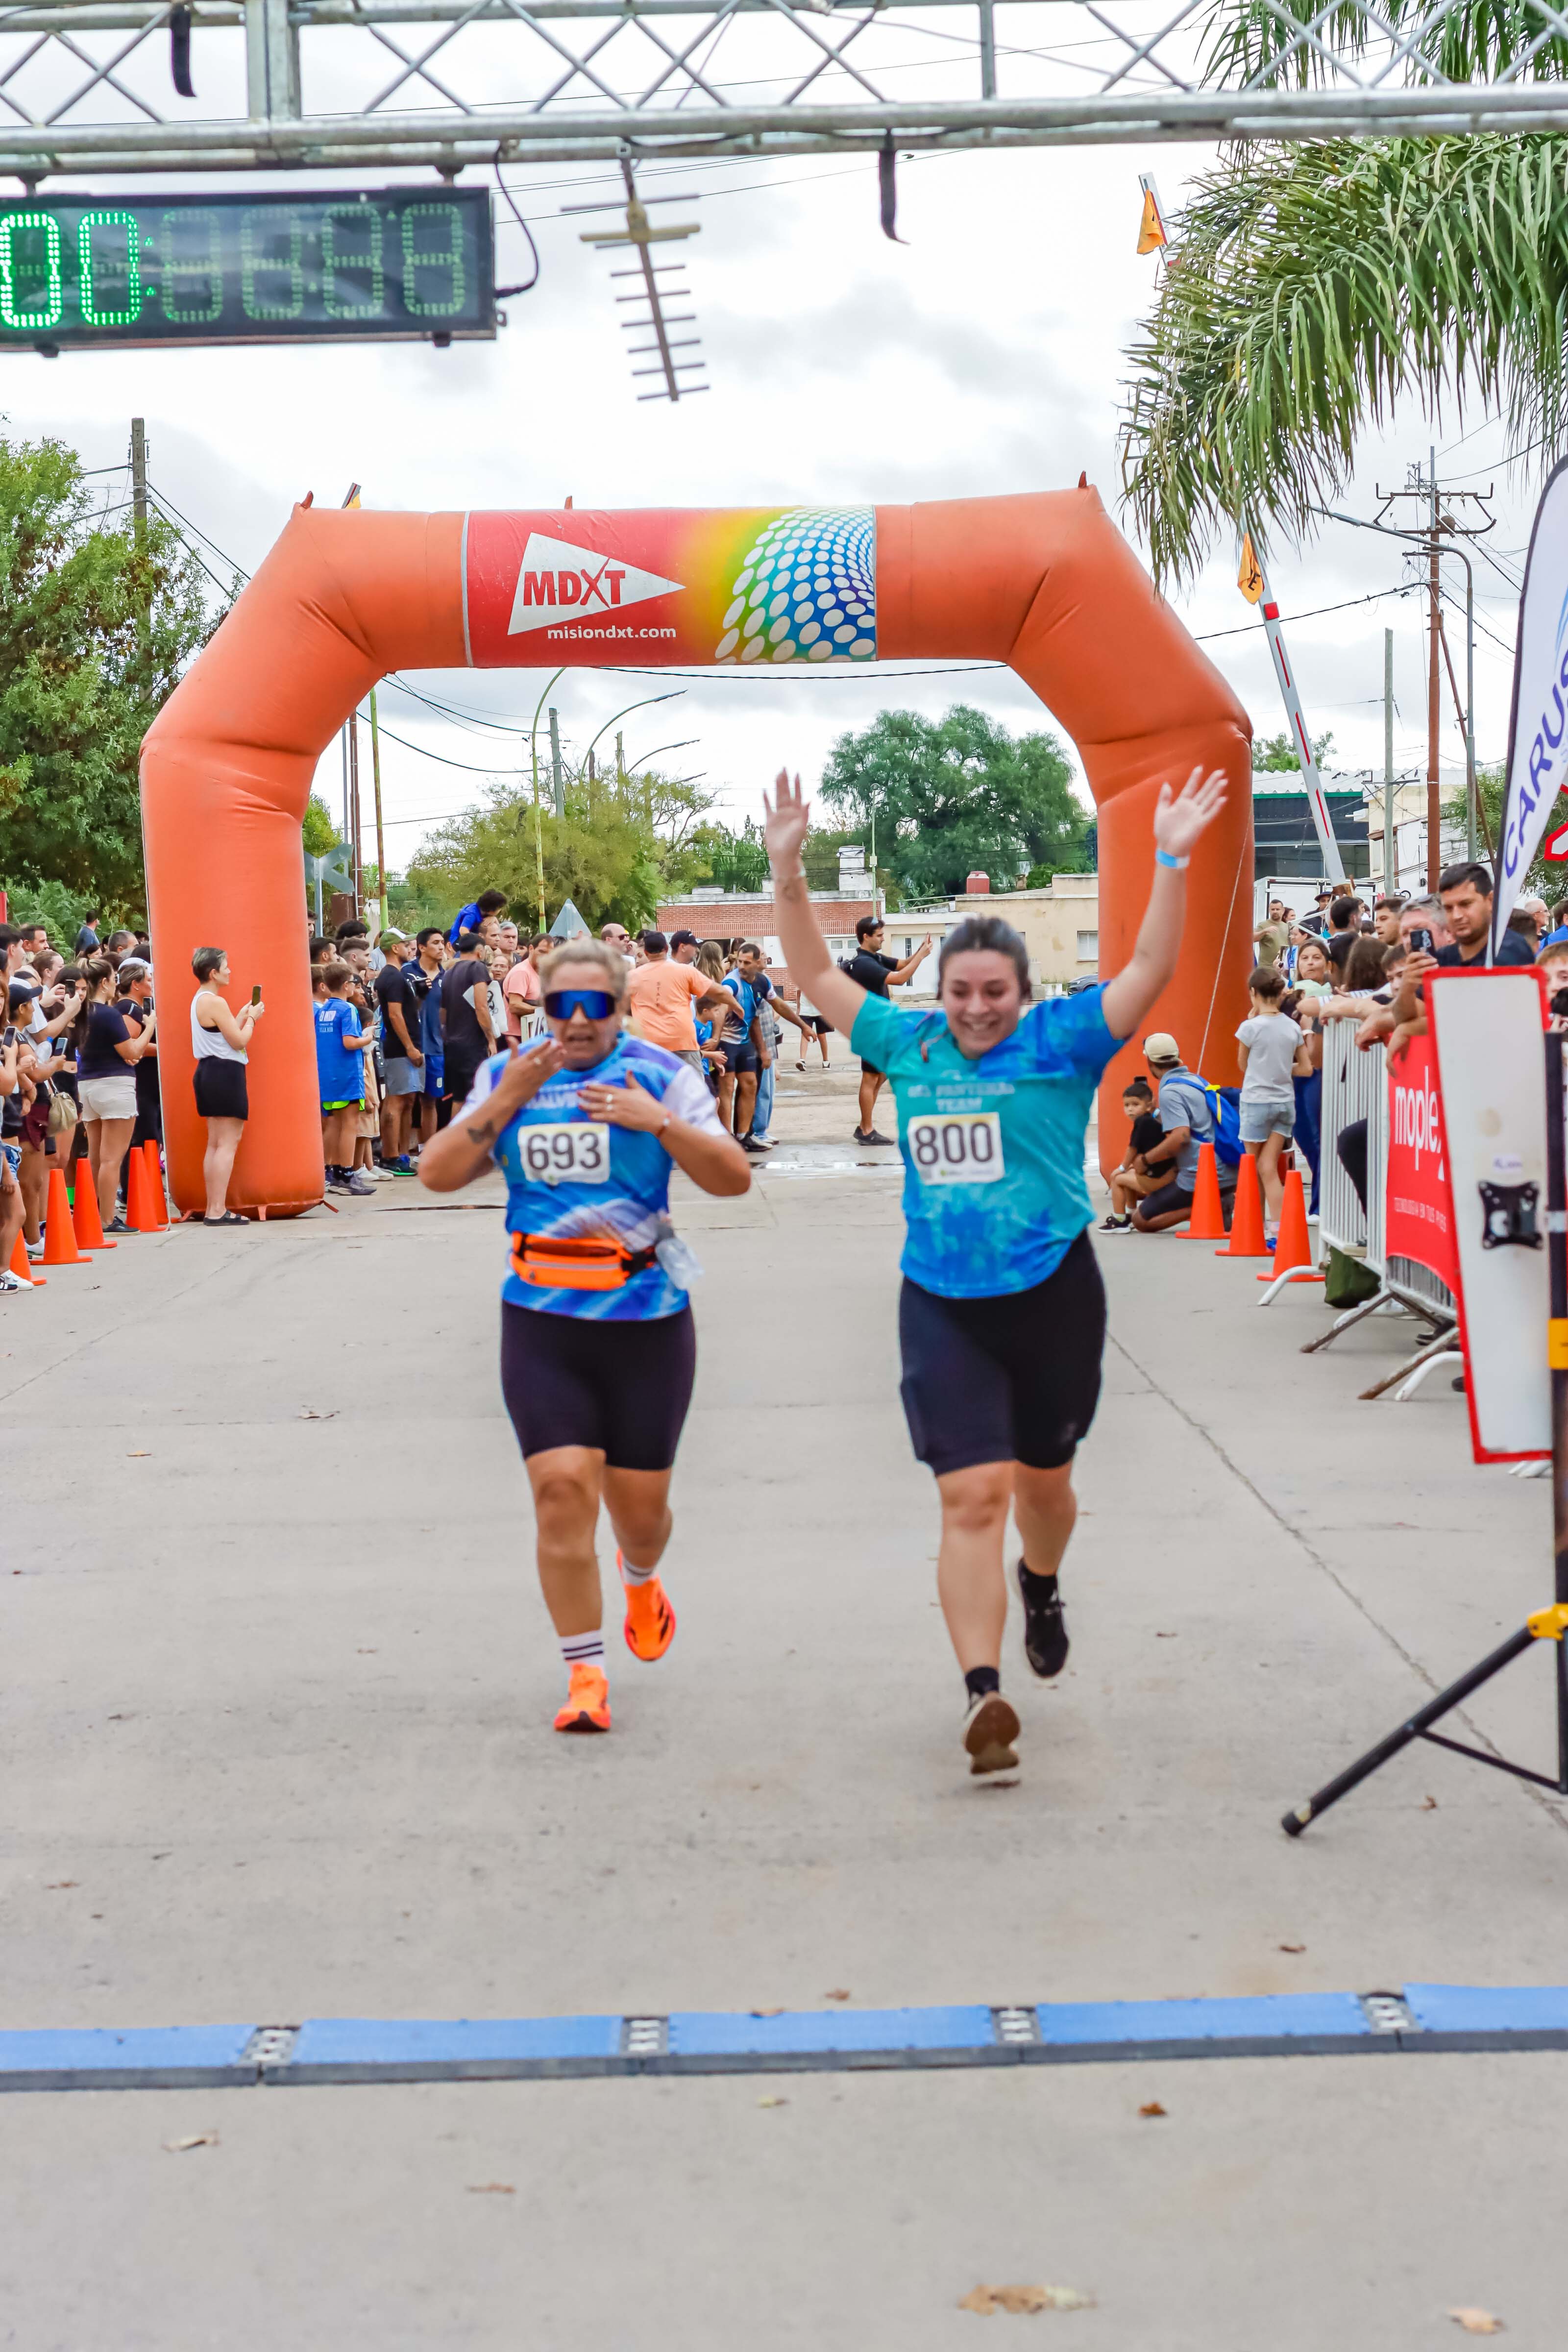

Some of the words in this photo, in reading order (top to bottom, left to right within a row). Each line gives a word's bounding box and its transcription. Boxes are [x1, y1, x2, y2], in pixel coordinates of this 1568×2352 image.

[523, 557, 626, 609] MDXT
[547, 625, 677, 640] misiondxt.com
[1395, 1065, 1442, 1171] mople
[527, 1131, 602, 1170] 693
[915, 1122, 993, 1165] 800
